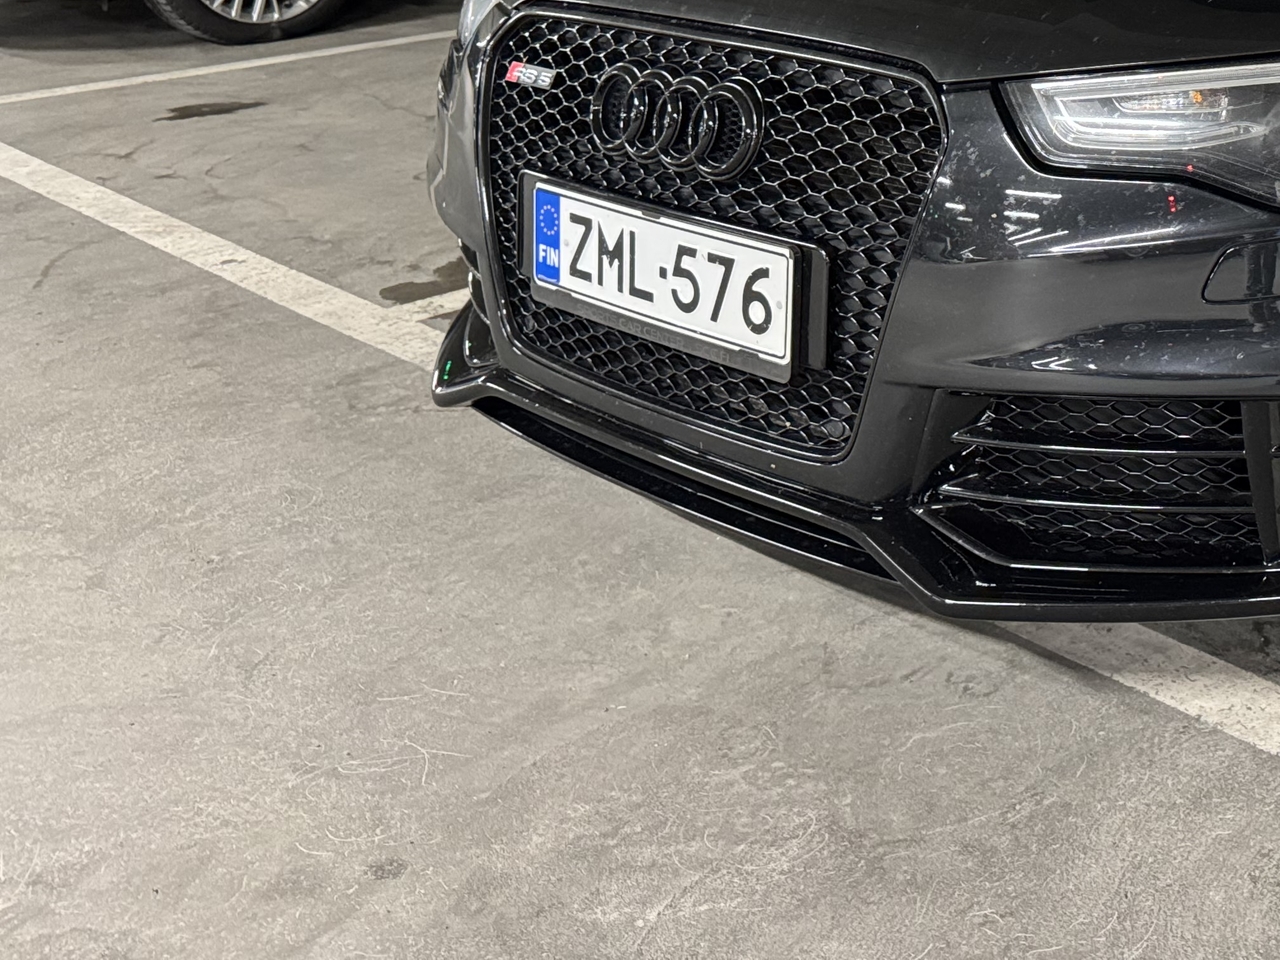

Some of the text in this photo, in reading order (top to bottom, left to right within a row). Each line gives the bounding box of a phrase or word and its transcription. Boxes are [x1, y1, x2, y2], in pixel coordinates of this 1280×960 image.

[538, 243, 559, 268] FIN
[569, 212, 773, 336] ZML-576
[576, 302, 618, 325] SPORTS
[619, 317, 642, 335] CAR
[643, 326, 684, 349] CENTER
